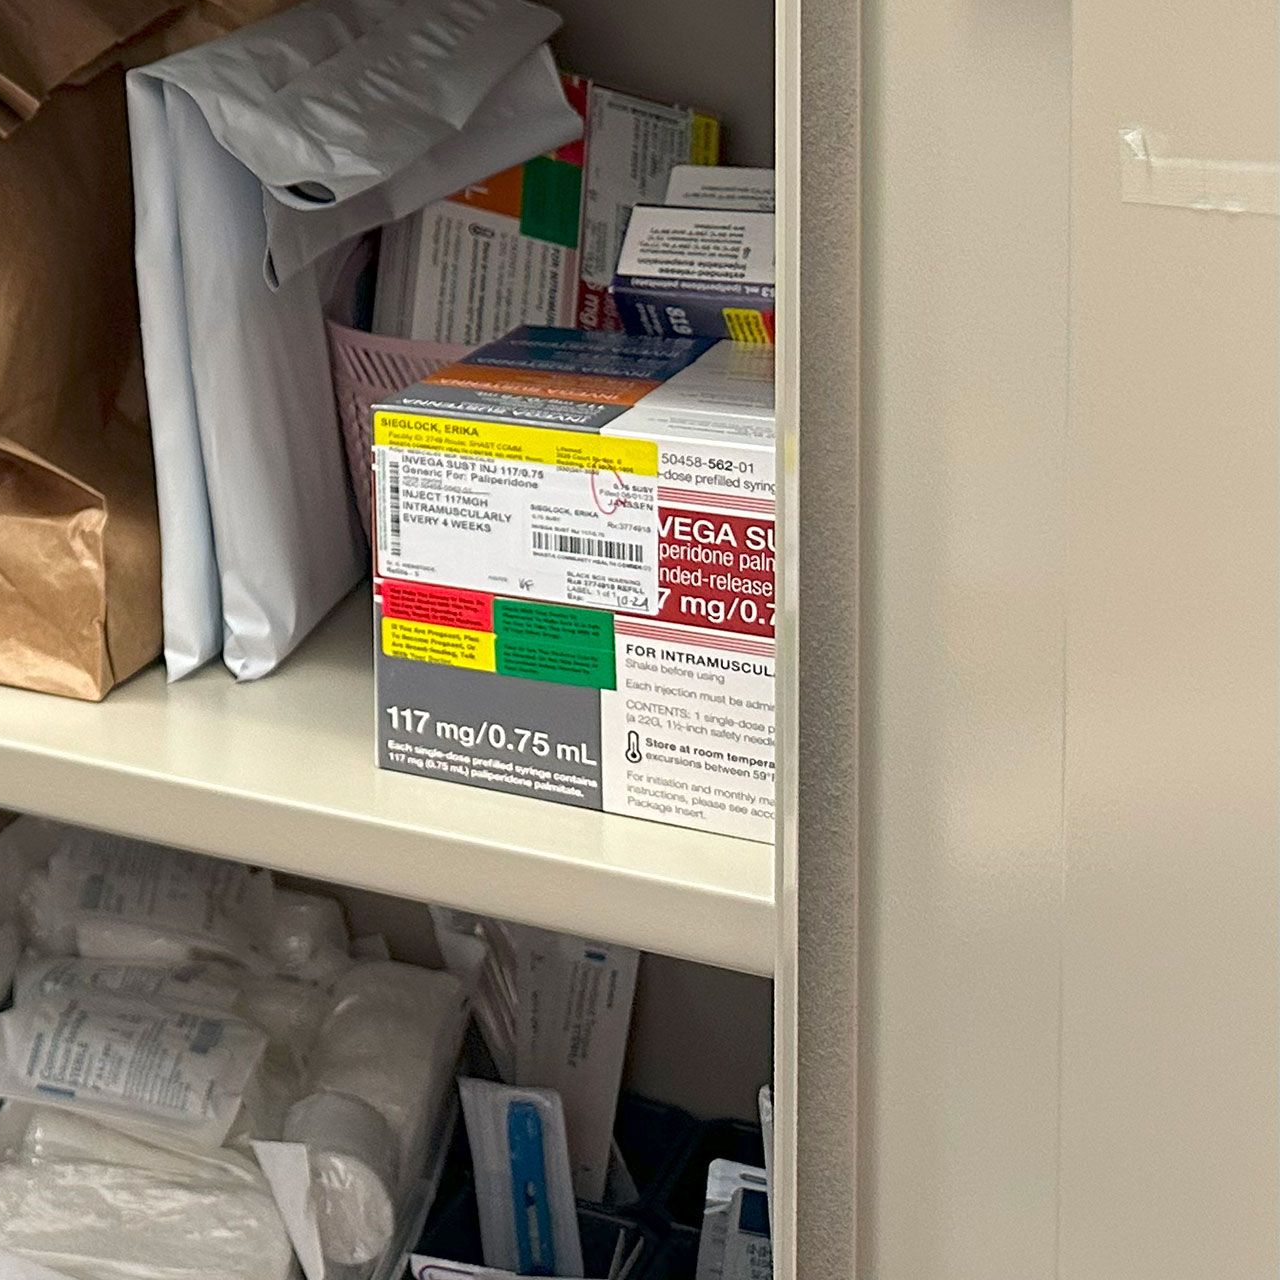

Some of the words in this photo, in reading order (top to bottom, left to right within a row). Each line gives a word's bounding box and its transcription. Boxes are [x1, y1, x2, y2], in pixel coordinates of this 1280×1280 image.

[401, 397, 508, 415] SUSTENNA
[510, 407, 588, 423] INVEGA
[381, 417, 442, 433] SIEGLOCK,
[444, 424, 480, 436] ERIKA
[402, 455, 443, 467] INVEGA
[446, 460, 476, 470] SUST
[480, 464, 496, 473] INJ
[662, 453, 754, 474] 50458-562-01
[402, 465, 443, 477] Generic
[471, 473, 539, 488] Paliperidone
[695, 474, 740, 488] prefilled
[402, 489, 441, 502] INJECT
[402, 501, 512, 523] INTRAMUSCULARLY
[403, 513, 439, 525] EVERY
[451, 520, 492, 532] WEEKS
[659, 542, 734, 566] peridone
[659, 566, 773, 596] nded-release
[626, 643, 656, 659] FOR
[661, 650, 775, 677] INTRAMUSCUL
[626, 659, 658, 671] Shake
[660, 664, 694, 679] before
[696, 671, 726, 685] using
[626, 679, 652, 692] Each
[654, 683, 697, 699] injection
[699, 692, 727, 704] must
[729, 696, 743, 707] be
[626, 699, 691, 720] CONTENTS:
[704, 713, 765, 732] single-dose
[386, 706, 430, 734] 117
[436, 721, 550, 757] mg/0.75
[556, 743, 598, 766] mL
[710, 727, 741, 742] safety
[645, 737, 677, 751] Store
[679, 744, 691, 754] at
[693, 748, 724, 760] room
[387, 739, 413, 753] Each
[414, 745, 471, 764] single-dose
[472, 757, 513, 771] prefilled
[515, 764, 552, 780] syringe
[553, 771, 598, 787] contains
[645, 752, 702, 769] excursions
[705, 761, 751, 778] between
[389, 753, 406, 763] 117
[407, 756, 424, 769] mg
[471, 768, 532, 788] paliperidone
[534, 779, 585, 798] palmitate.
[626, 770, 643, 782] For
[646, 773, 689, 790] initiation
[691, 783, 711, 794] and
[714, 787, 756, 805] monthly
[627, 785, 689, 804] instructions,
[691, 796, 727, 811] please
[729, 803, 748, 815] see
[627, 796, 673, 813] Package
